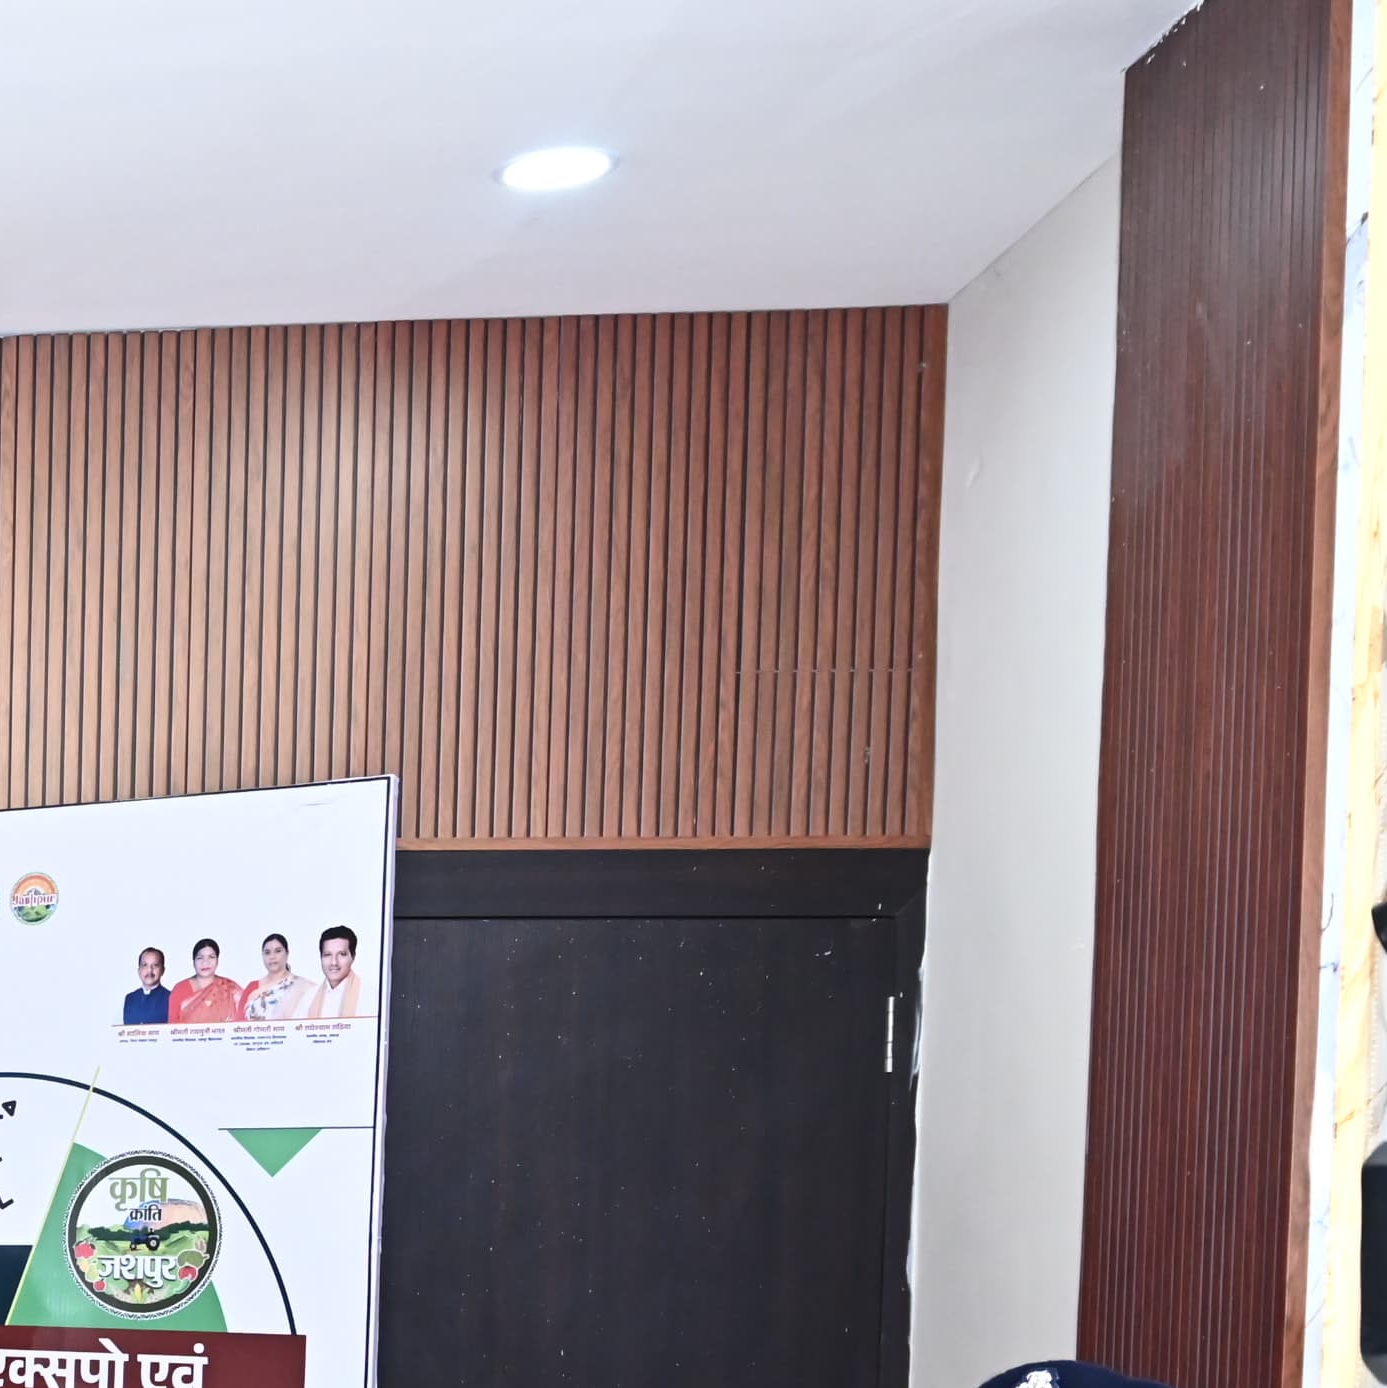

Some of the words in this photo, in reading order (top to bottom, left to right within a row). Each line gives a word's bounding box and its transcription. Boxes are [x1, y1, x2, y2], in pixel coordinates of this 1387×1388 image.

[108, 1167, 171, 1212] कृषि
[129, 1204, 163, 1222] क्रांति
[97, 1254, 178, 1289] जशपुर
